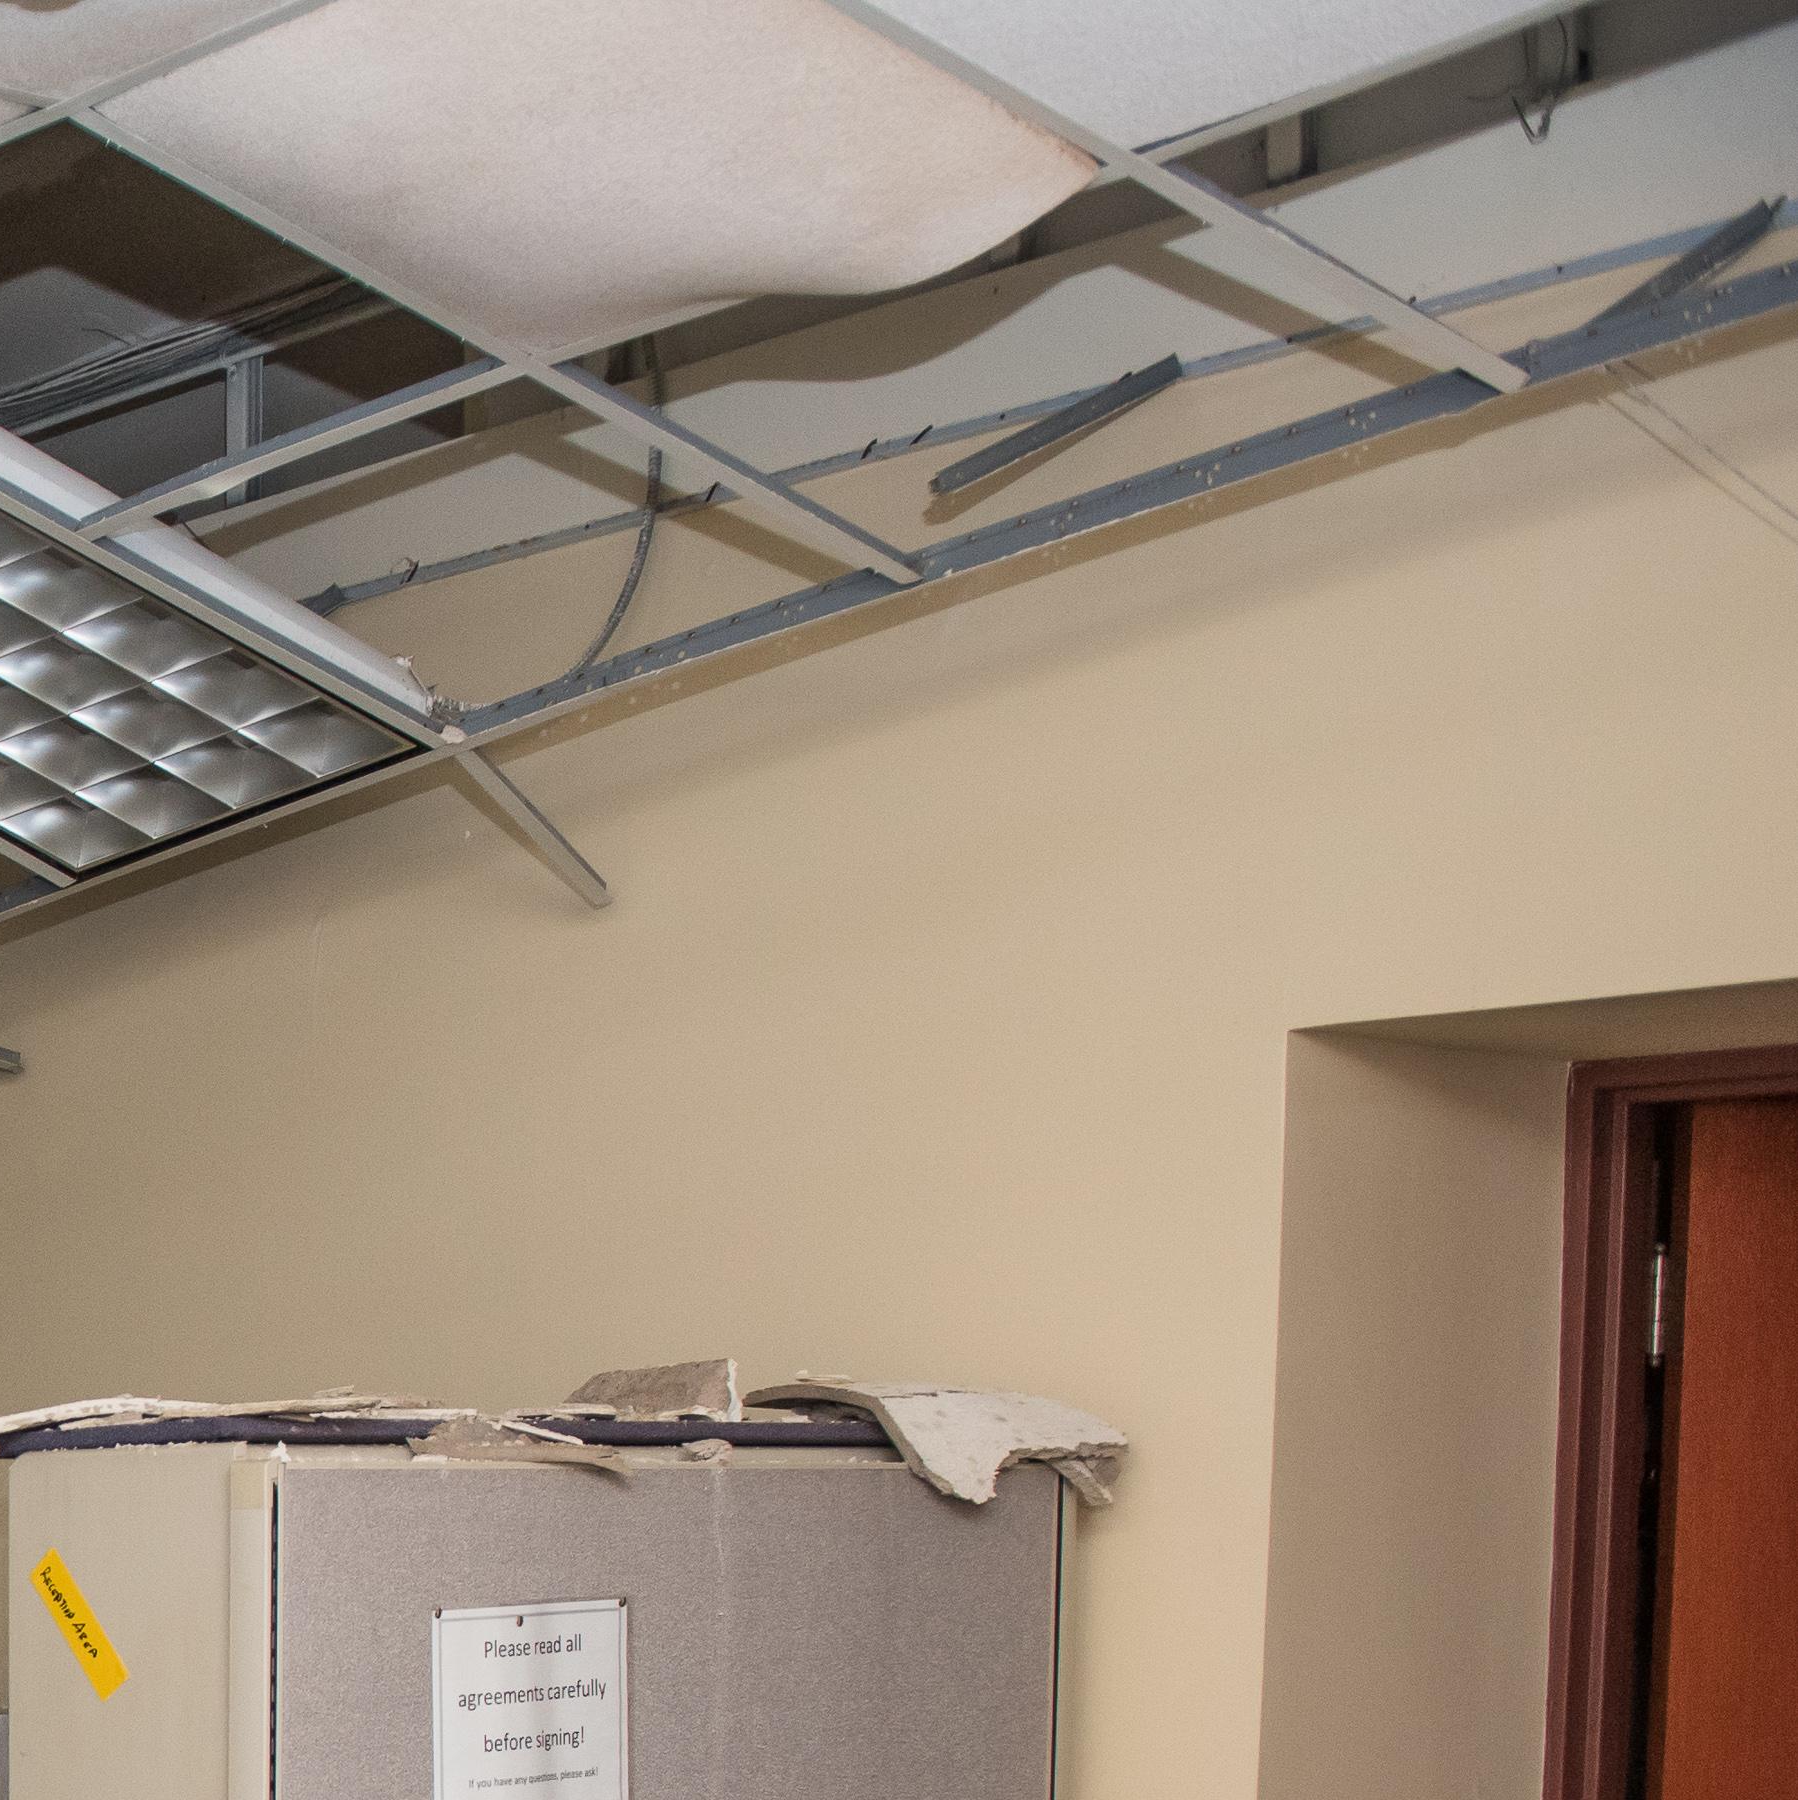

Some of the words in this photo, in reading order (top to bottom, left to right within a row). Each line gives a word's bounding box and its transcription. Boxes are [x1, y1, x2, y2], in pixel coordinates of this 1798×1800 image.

[484, 1640, 531, 1658] Please
[534, 1635, 561, 1655] read
[566, 1633, 582, 1652] all
[458, 1684, 545, 1711] agreements
[547, 1678, 607, 1700] carefully
[484, 1732, 533, 1752] before
[536, 1726, 585, 1751] signing!
[468, 1779, 474, 1789] If
[476, 1778, 492, 1790] you
[494, 1775, 512, 1787] have
[514, 1773, 527, 1785] any
[560, 1768, 583, 1782] please
[584, 1766, 599, 1778] ask!
